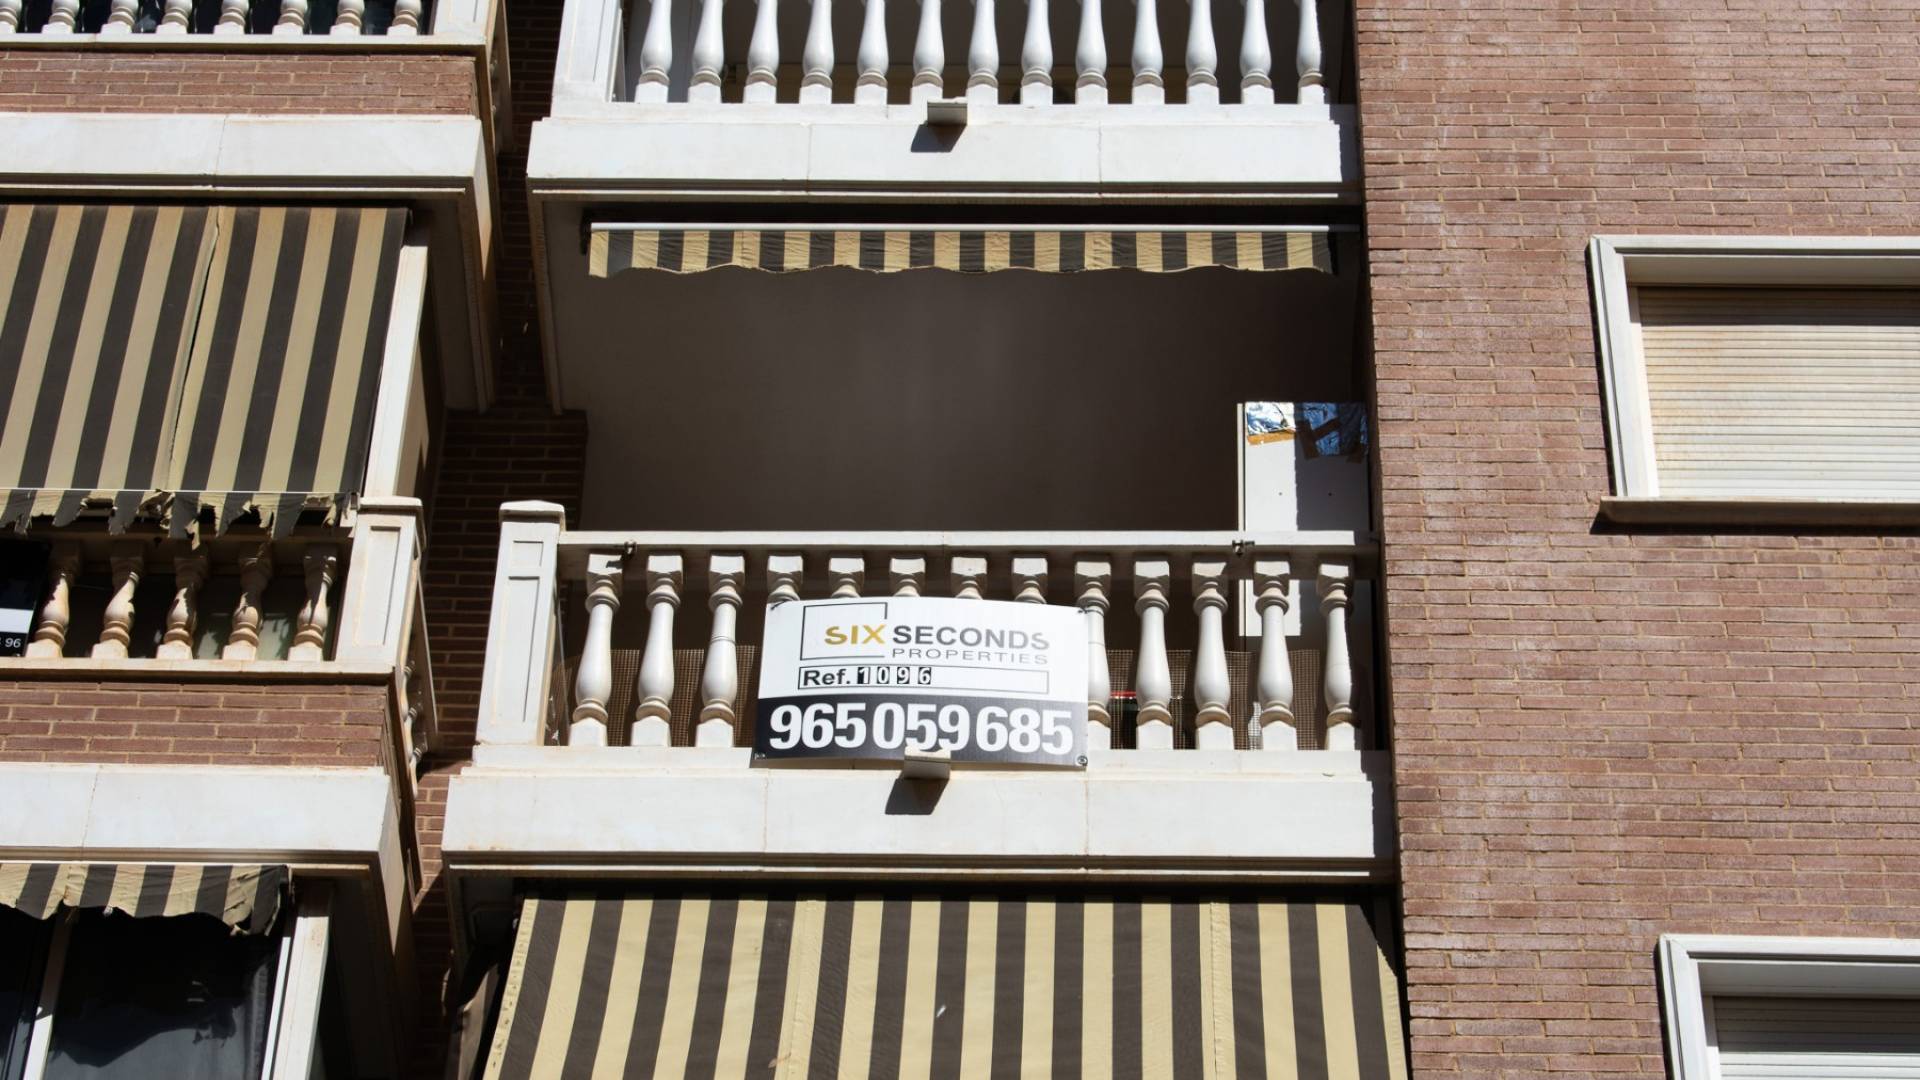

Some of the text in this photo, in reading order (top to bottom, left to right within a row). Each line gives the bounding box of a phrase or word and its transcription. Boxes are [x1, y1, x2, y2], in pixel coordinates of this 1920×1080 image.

[5, 638, 21, 648] 96
[824, 625, 1050, 651] SIX SECONDS
[892, 648, 1048, 665] PROPERTIES
[803, 666, 932, 686] Ref. 1096
[769, 703, 1074, 755] 965 059 685
